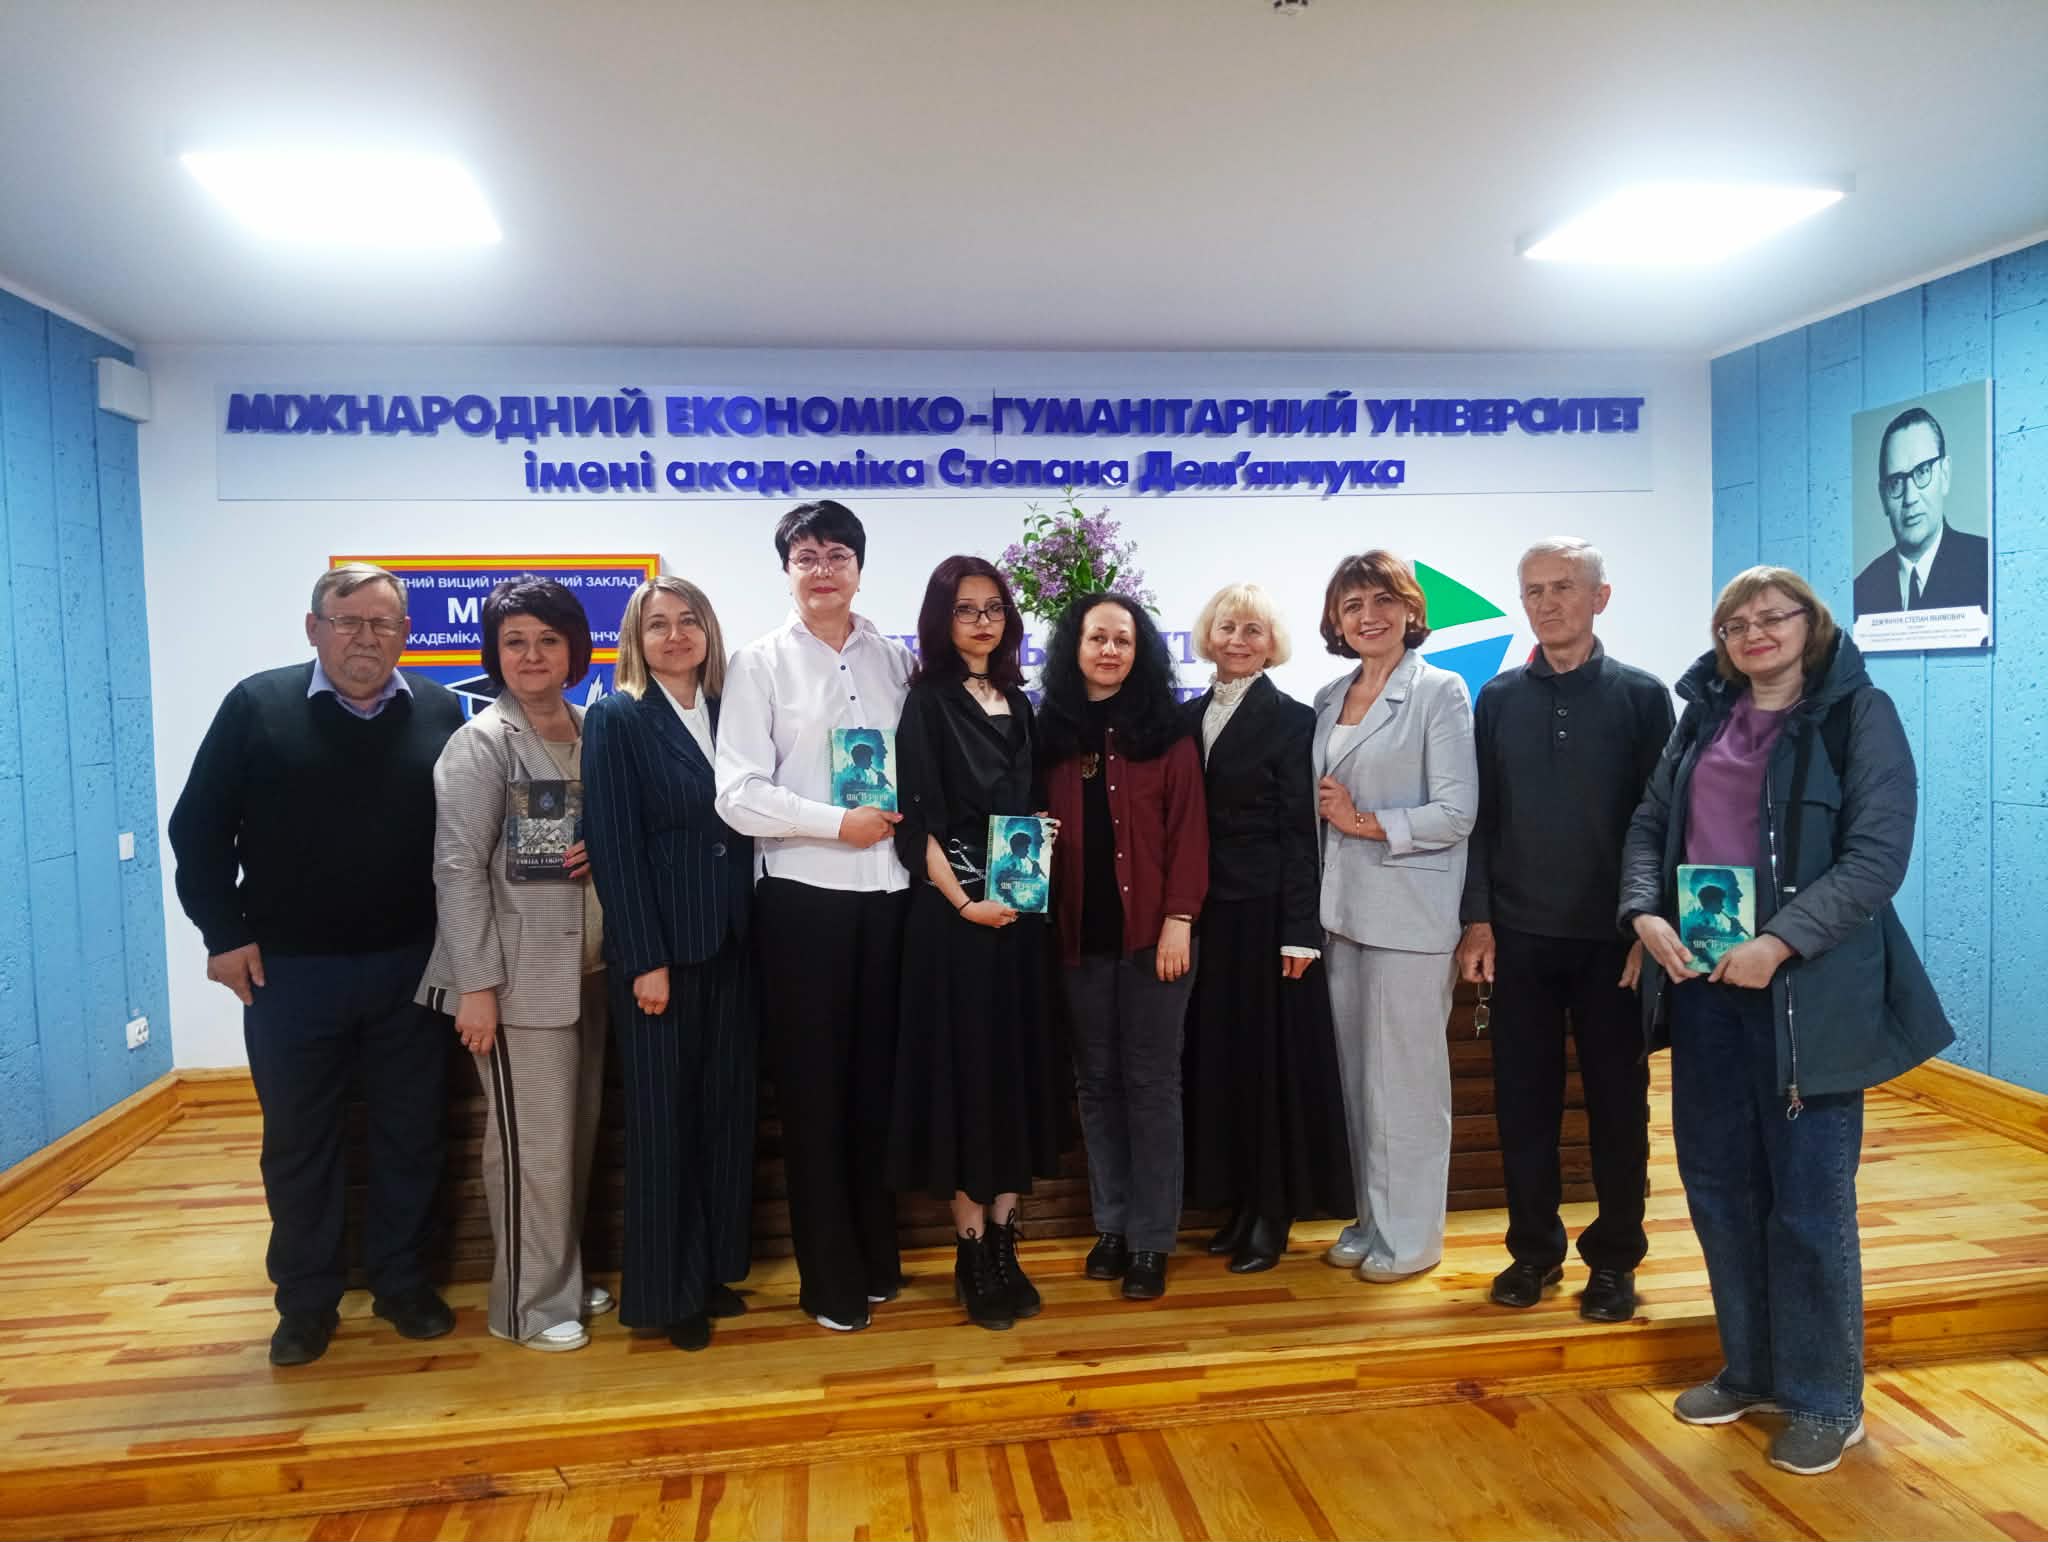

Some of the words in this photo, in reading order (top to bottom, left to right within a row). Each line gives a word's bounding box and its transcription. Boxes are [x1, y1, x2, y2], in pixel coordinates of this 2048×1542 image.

[226, 387, 653, 442] МІЖНАРОДНИЙ
[666, 388, 1356, 436] ЕКОНОМІКО-ГУМАНІТАРНИЙ
[1365, 397, 1644, 434] УНІВЕРСИТЕТ
[524, 450, 655, 491] імені
[666, 448, 927, 495] академіка
[937, 448, 1129, 487] Степана
[438, 575, 489, 589] ВИЩИЙ
[586, 576, 638, 588] ЗАКЛАД
[406, 630, 481, 646] КАДЕМІКА
